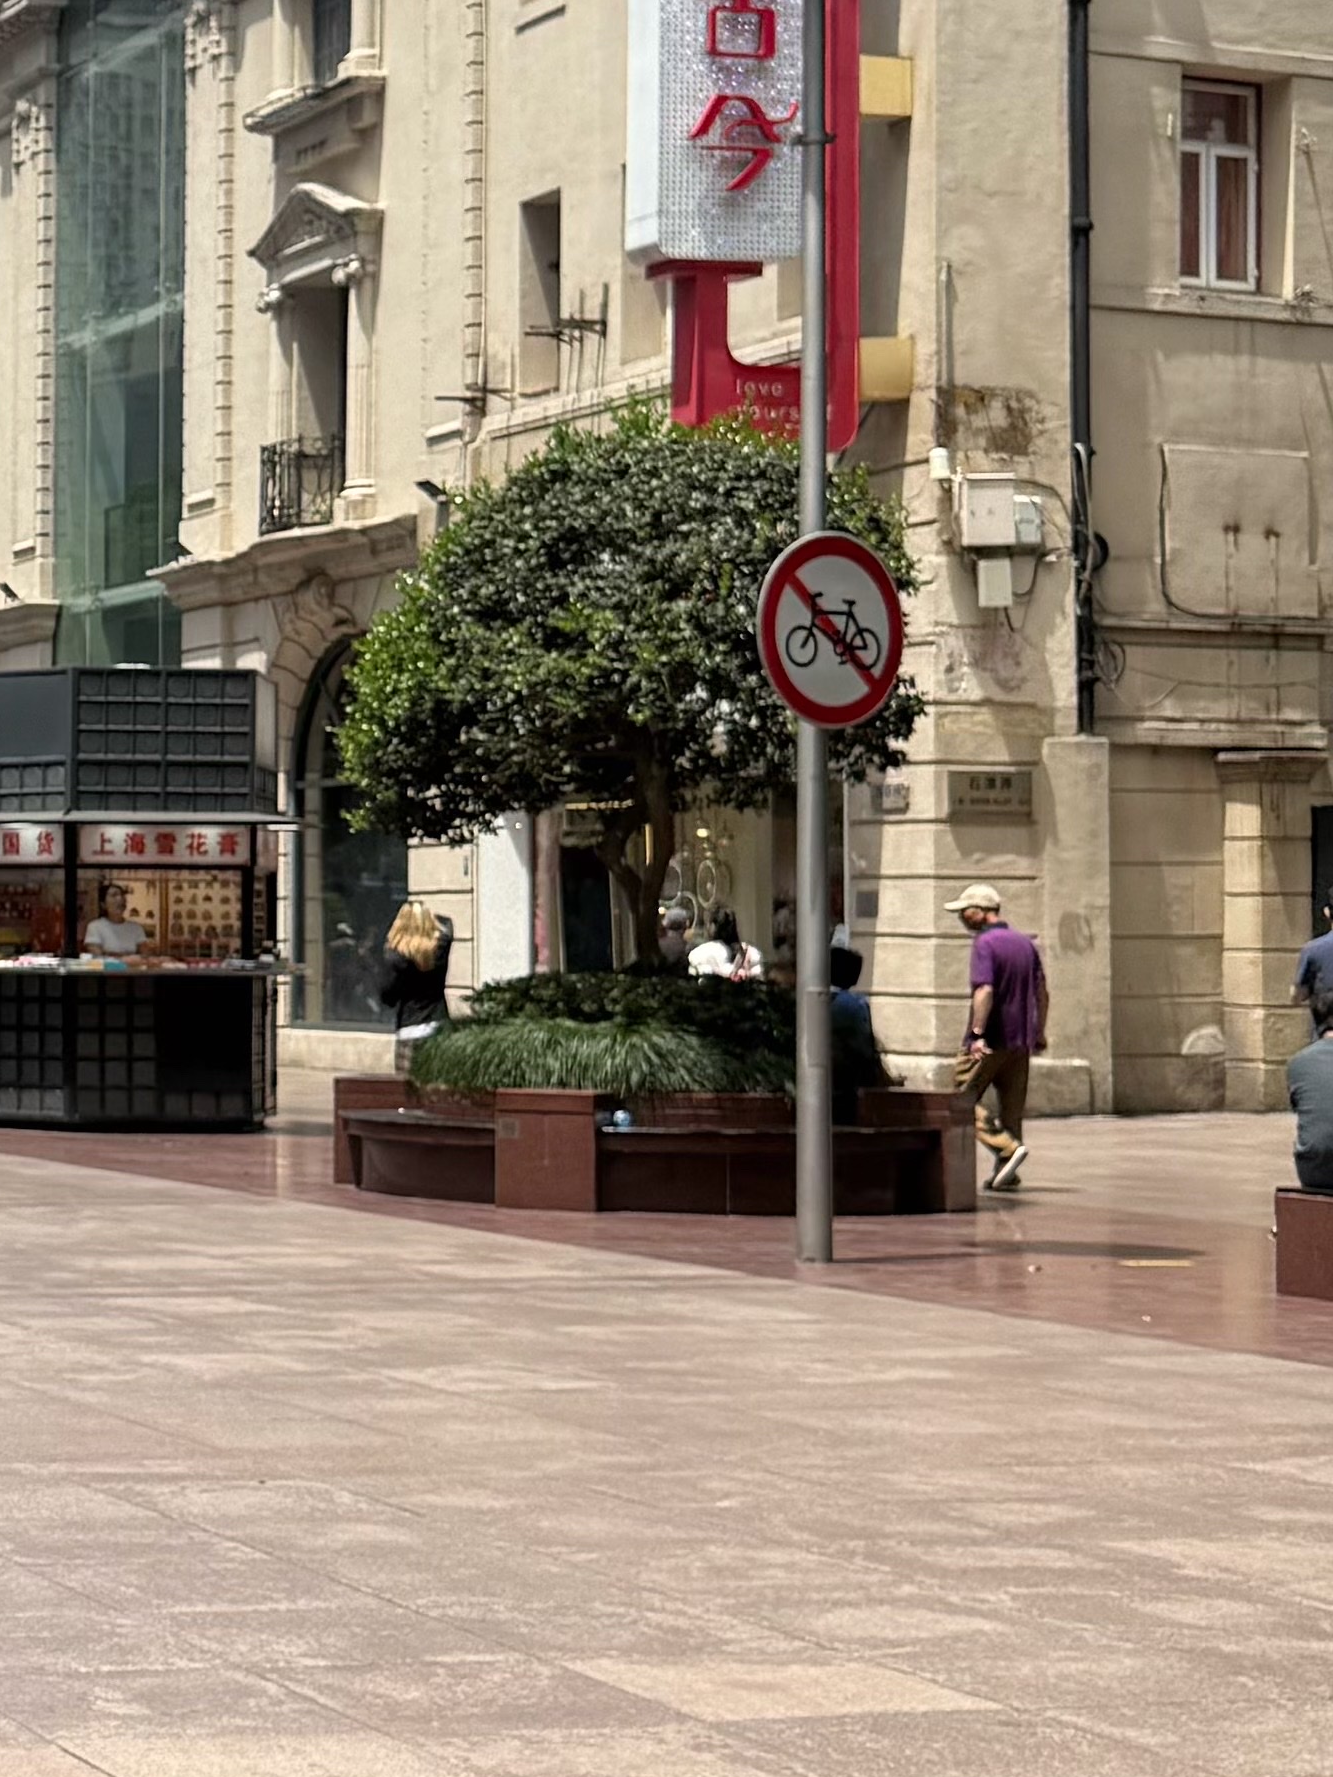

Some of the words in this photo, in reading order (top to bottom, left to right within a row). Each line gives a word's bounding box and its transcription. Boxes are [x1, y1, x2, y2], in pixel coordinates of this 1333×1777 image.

[736, 378, 784, 397] love
[93, 831, 239, 857] 上海雪花膏
